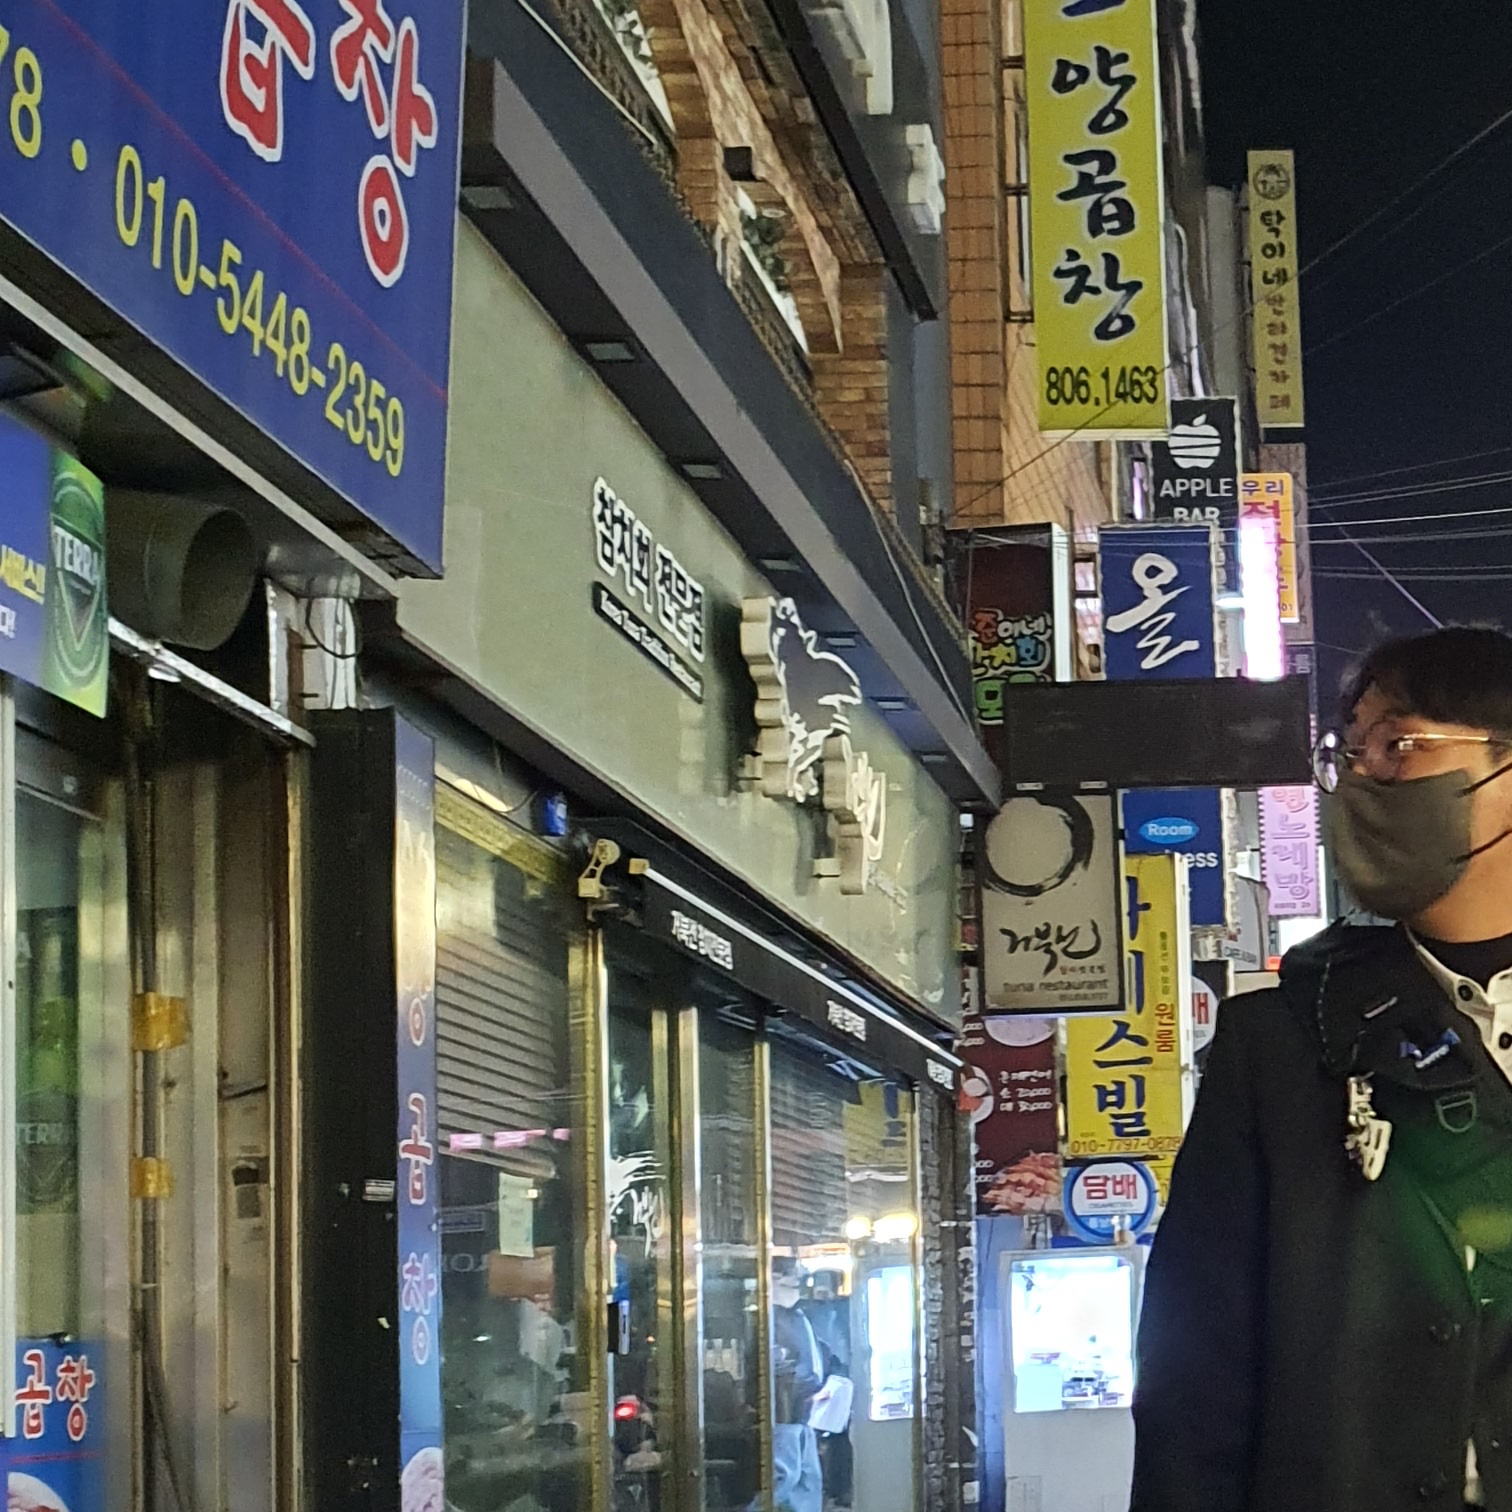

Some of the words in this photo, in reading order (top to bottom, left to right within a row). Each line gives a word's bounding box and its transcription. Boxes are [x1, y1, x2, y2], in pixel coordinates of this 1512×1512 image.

[115, 144, 405, 477] 010-5448-2359
[1045, 364, 1159, 406] 806.1463
[1160, 477, 1234, 498] APPLE
[1241, 479, 1284, 496] 우리
[1148, 823, 1194, 837] Room
[1270, 813, 1314, 900] 노래방
[1082, 1173, 1138, 1201] 담배
